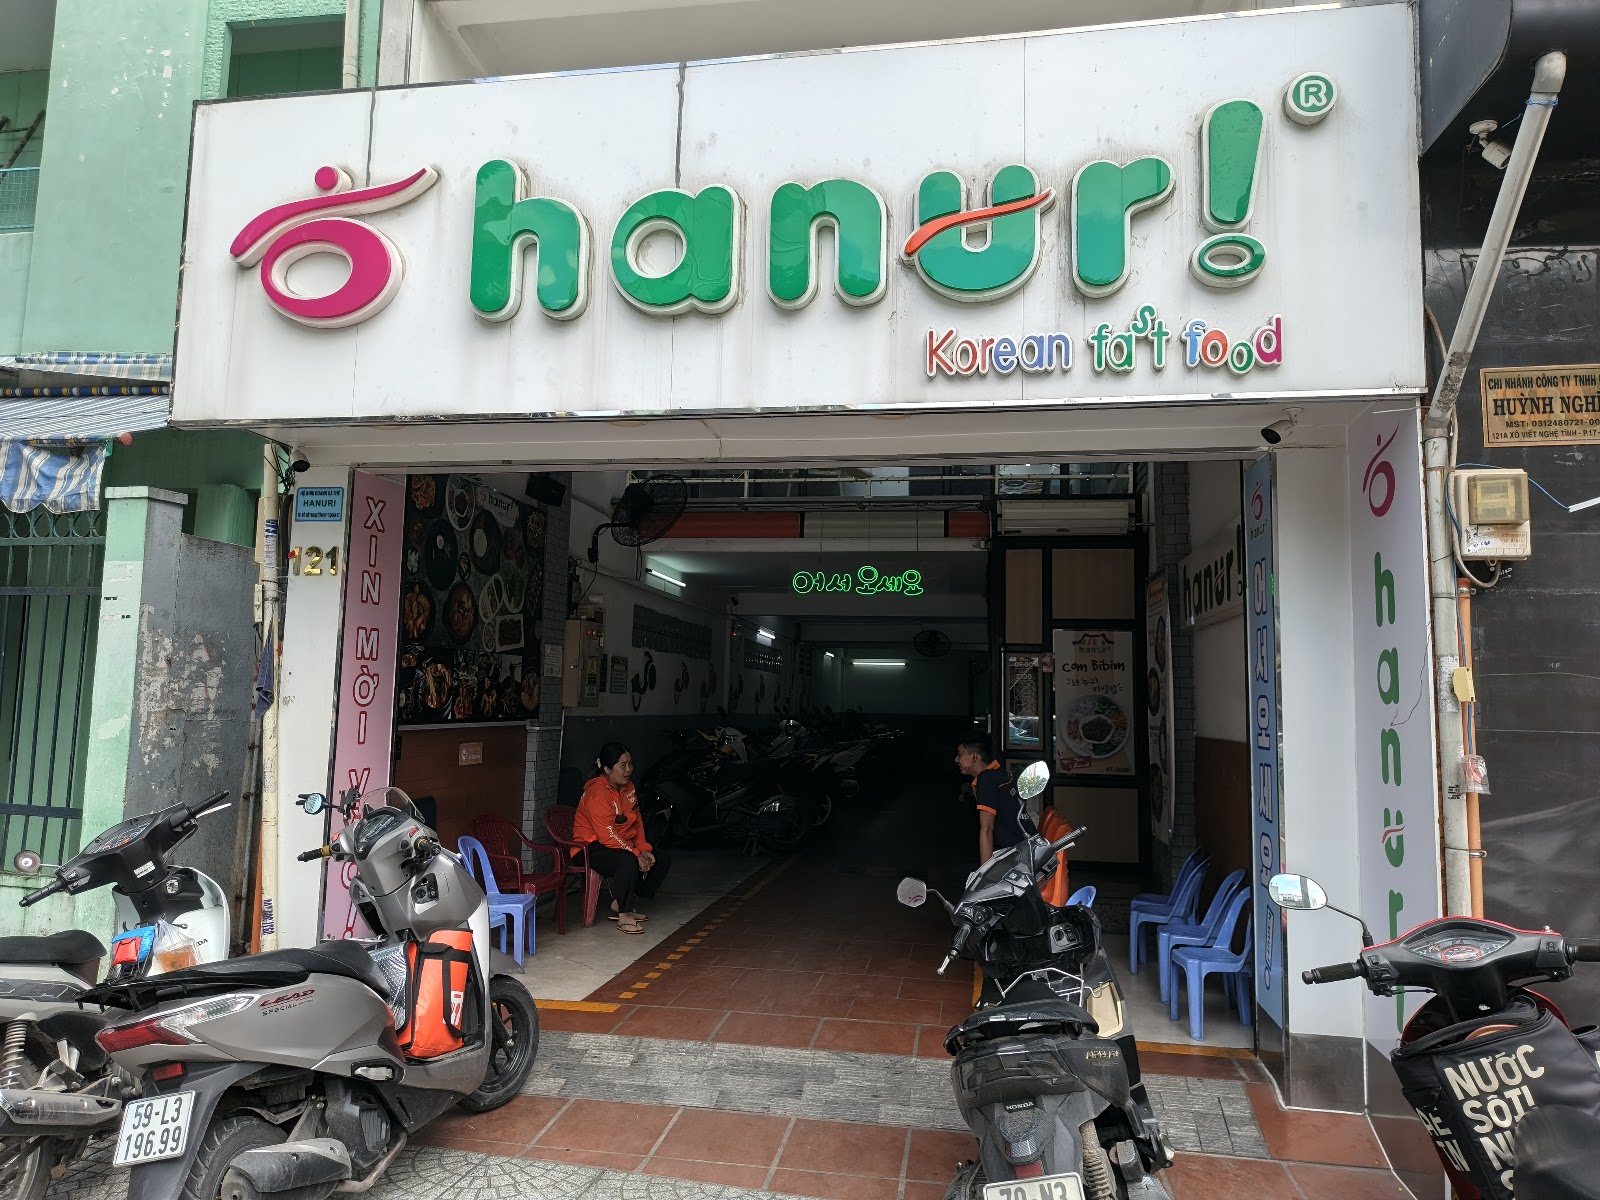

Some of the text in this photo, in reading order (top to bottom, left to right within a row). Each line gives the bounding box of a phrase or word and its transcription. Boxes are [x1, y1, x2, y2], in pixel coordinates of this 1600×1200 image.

[925, 303, 1282, 377] Korean fast food
[1488, 373, 1597, 390] CHI NHÁNH CÔNG TY TNHH
[1493, 392, 1555, 416] HUỲNH
[1506, 420, 1529, 428] MST:
[302, 499, 337, 508] HANURI
[292, 546, 339, 576] 121
[361, 495, 387, 605] XIN
[792, 565, 924, 596] 어서 오세요
[1091, 659, 1125, 672] Bibim
[353, 626, 380, 745] MỜI
[1443, 1044, 1545, 1101] NƯỚC
[131, 1095, 182, 1131] 59-L3
[1005, 1101, 1035, 1110] HONDA
[123, 1126, 182, 1161] 196.99
